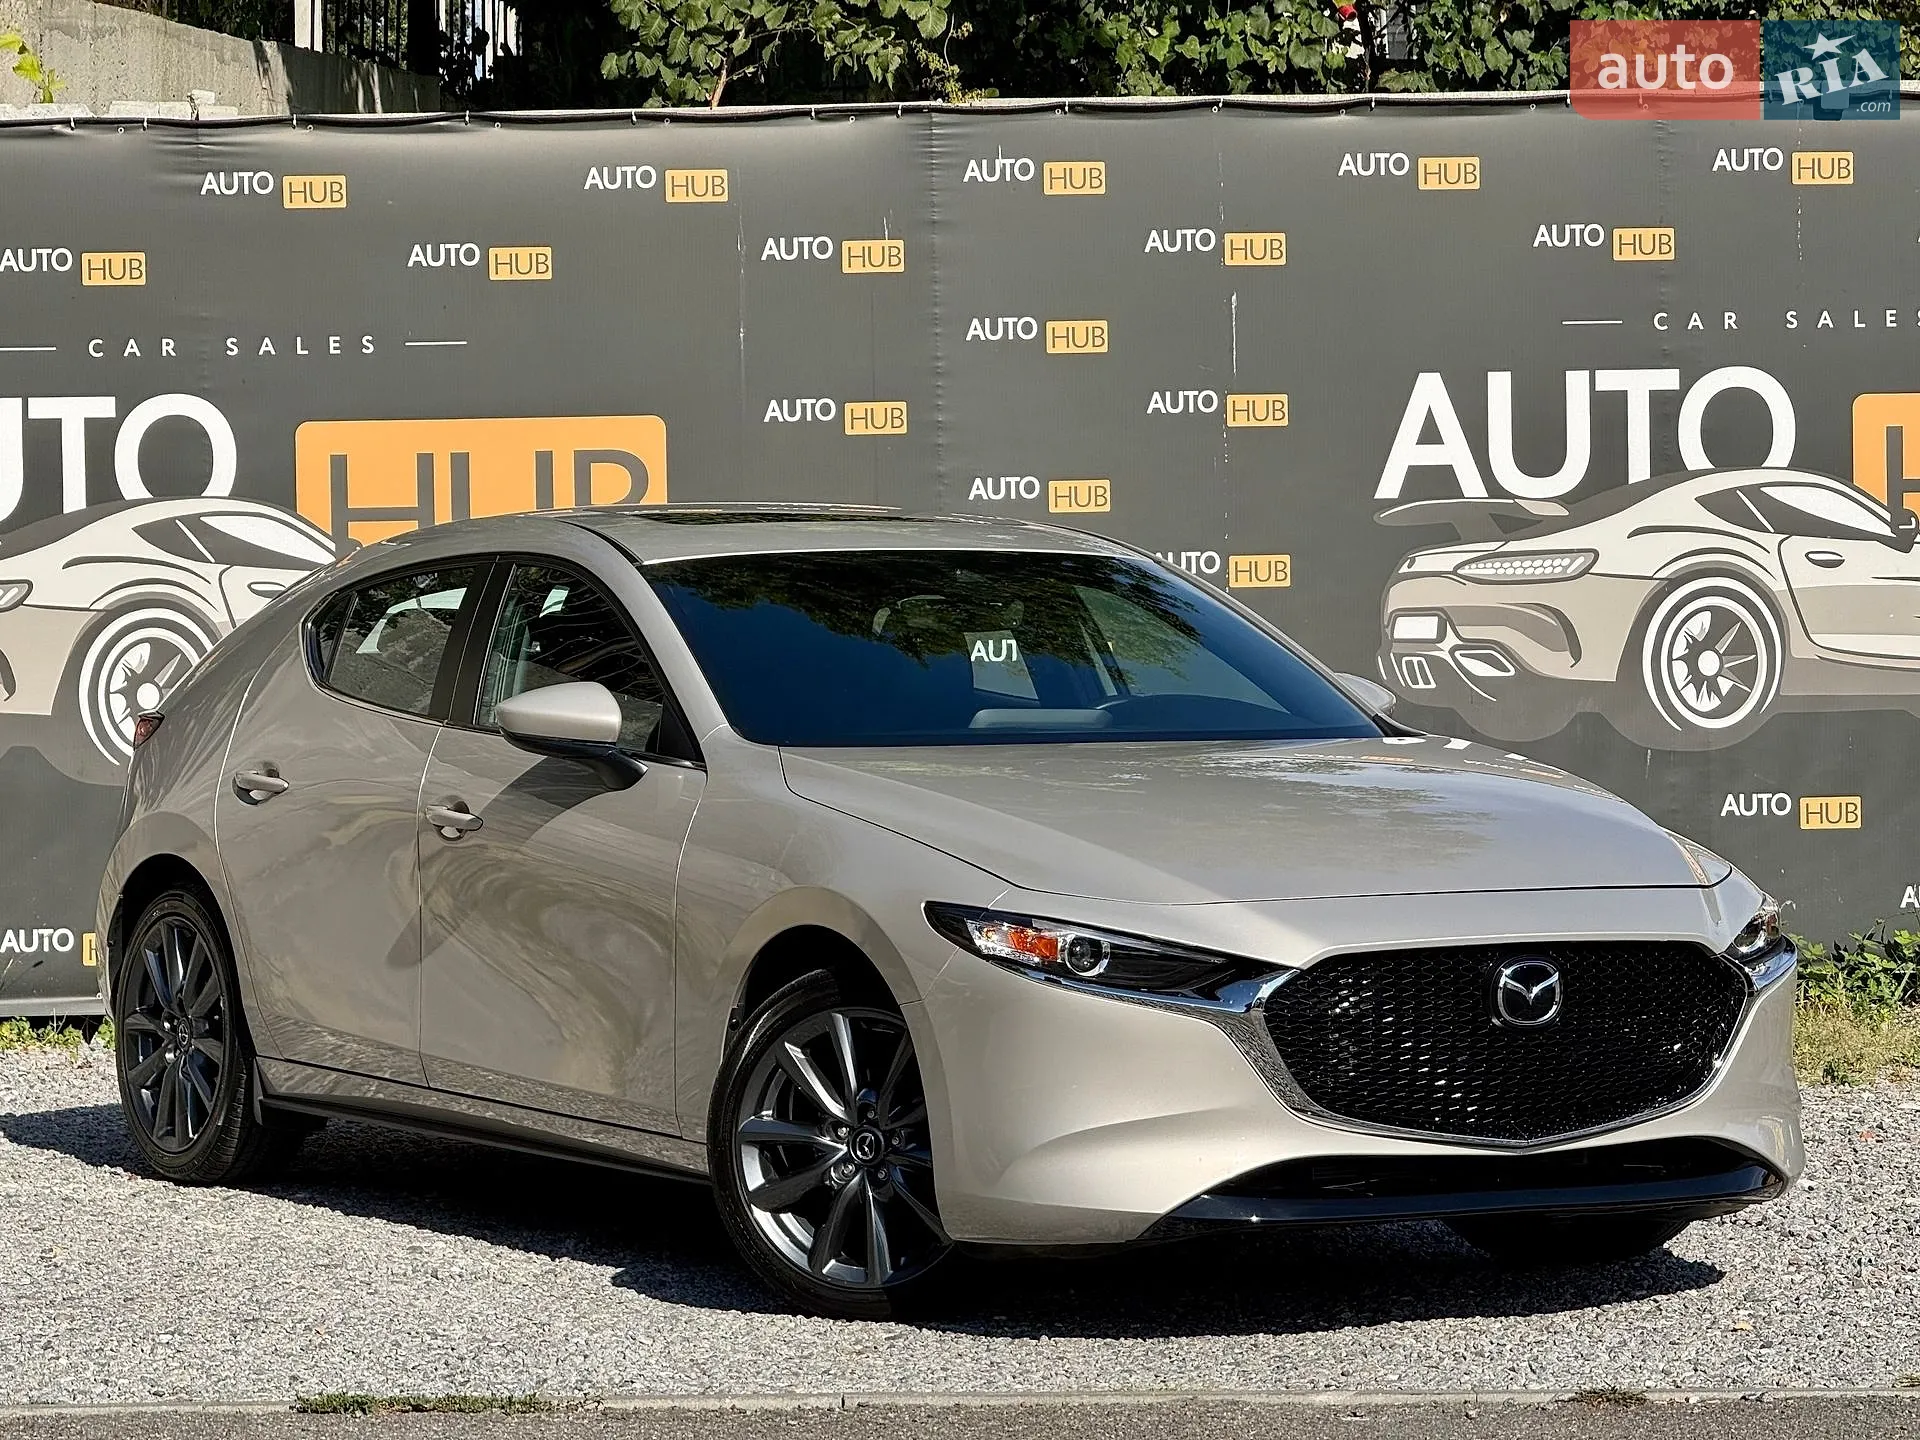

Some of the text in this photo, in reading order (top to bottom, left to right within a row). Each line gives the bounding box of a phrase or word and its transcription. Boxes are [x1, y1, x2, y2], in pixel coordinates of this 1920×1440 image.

[963, 158, 1103, 190] AUTO HUB
[1338, 152, 1477, 185] AUTO HUB
[1712, 147, 1851, 180] AUTO HUB
[200, 170, 344, 204] AUTO HUB
[583, 165, 725, 198] AUTO HUB
[761, 235, 902, 269] AUTO HUB
[1144, 228, 1284, 262] AUTO HUB
[1533, 223, 1672, 256] AUTO HUB
[0, 247, 145, 281] AUTO HUB
[407, 242, 550, 276] AUTO HUB
[966, 316, 1106, 350] AUTO HUB
[1653, 309, 1920, 331] CAR SALE
[88, 335, 375, 358] CAR SALES
[763, 397, 905, 431] AUTO HUB
[1146, 389, 1287, 422] AUTO HUB
[1373, 365, 1796, 498] AUTO
[968, 476, 1108, 509] AUTO HUB
[1234, 560, 1289, 584] HUB
[970, 639, 1017, 662] AUT
[1720, 792, 1859, 825] AUTO HUB
[0, 928, 75, 953] AUTO
